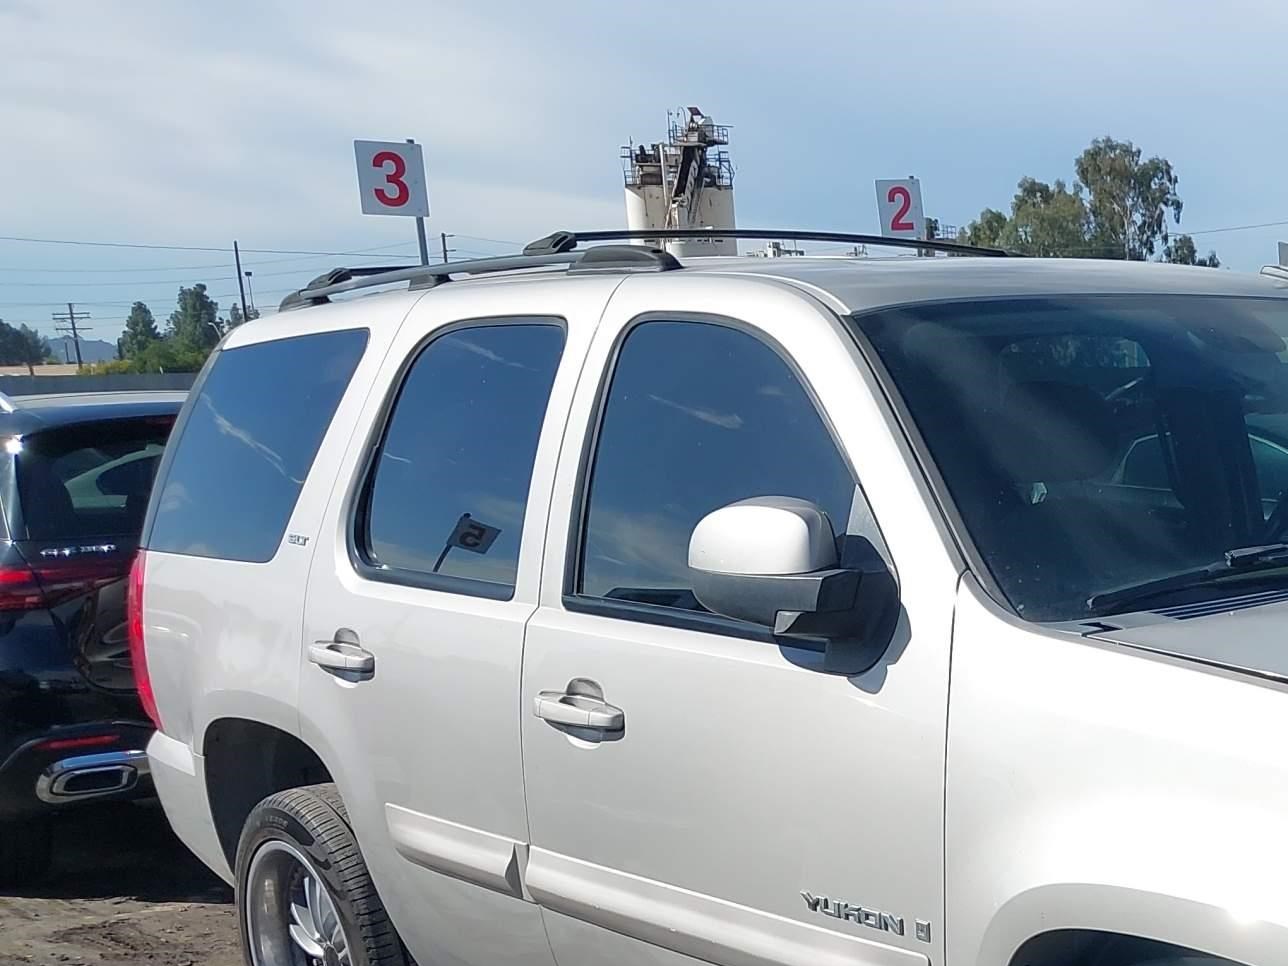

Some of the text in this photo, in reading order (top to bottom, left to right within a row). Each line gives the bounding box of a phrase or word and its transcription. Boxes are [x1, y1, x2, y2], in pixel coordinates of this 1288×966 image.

[373, 151, 409, 207] 3
[887, 186, 914, 231] 2
[800, 890, 905, 936] YUKON
